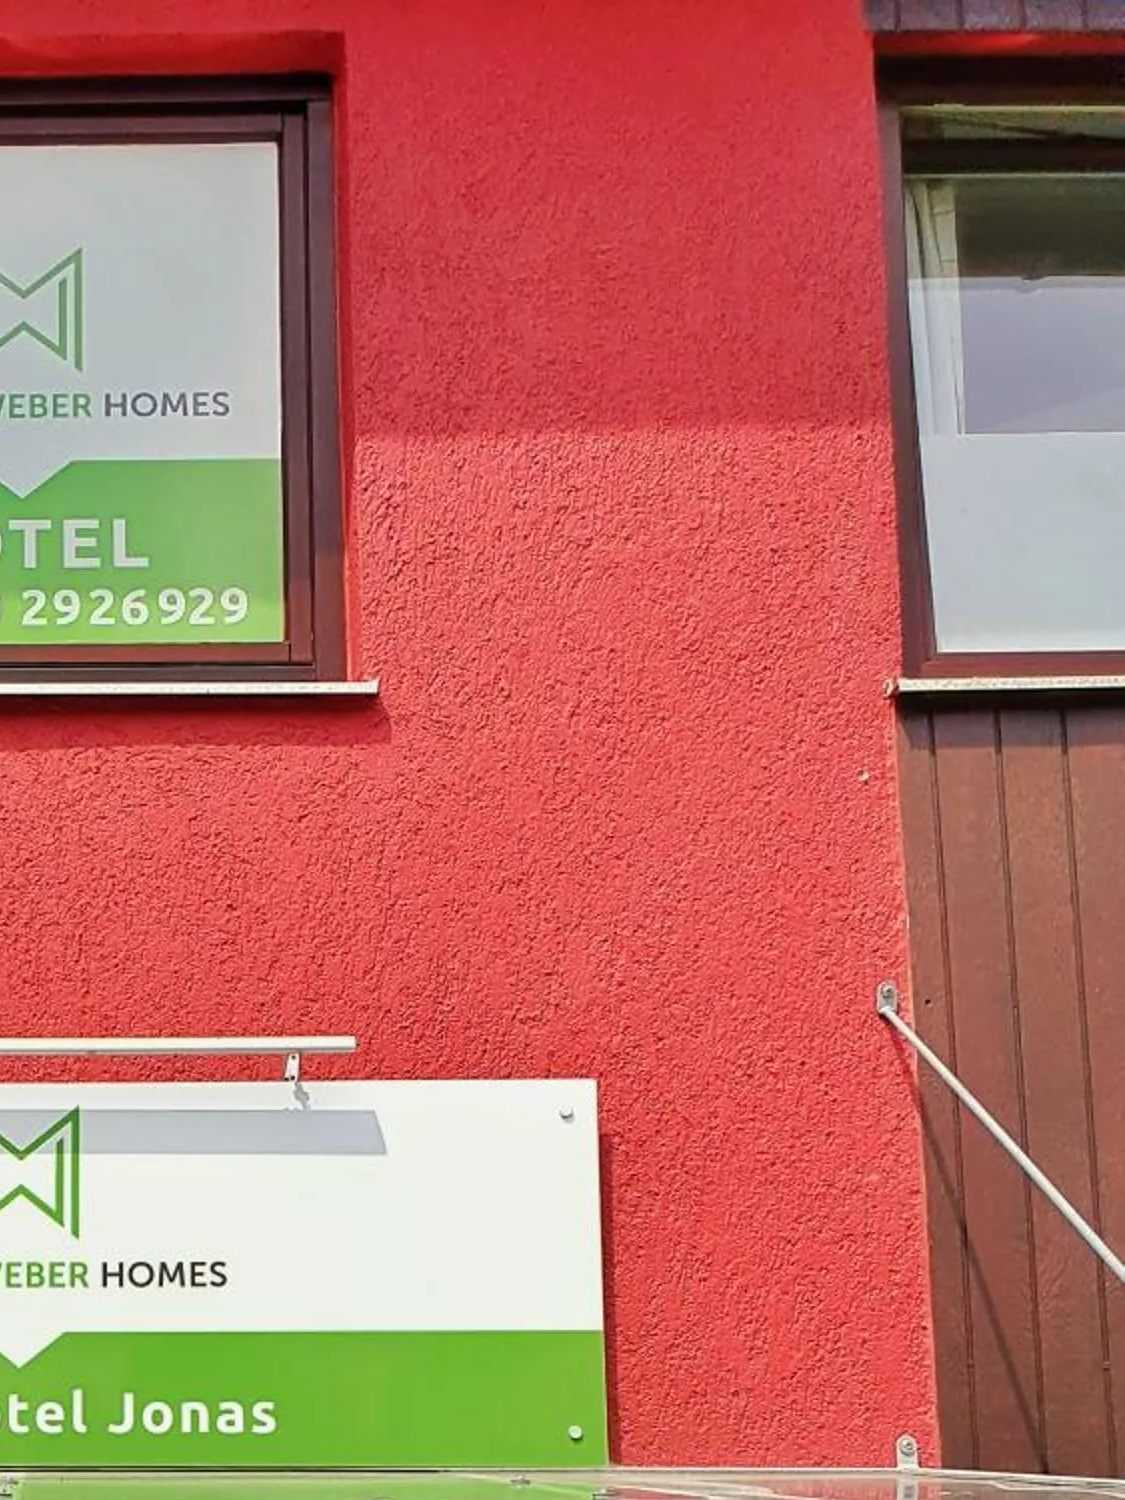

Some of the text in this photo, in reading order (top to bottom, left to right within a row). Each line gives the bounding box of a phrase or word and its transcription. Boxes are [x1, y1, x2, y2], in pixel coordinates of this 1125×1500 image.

[103, 391, 231, 418] HOMES
[21, 587, 249, 628] 2926929
[101, 1260, 229, 1288] HOMES
[107, 1391, 278, 1435] Jonas
